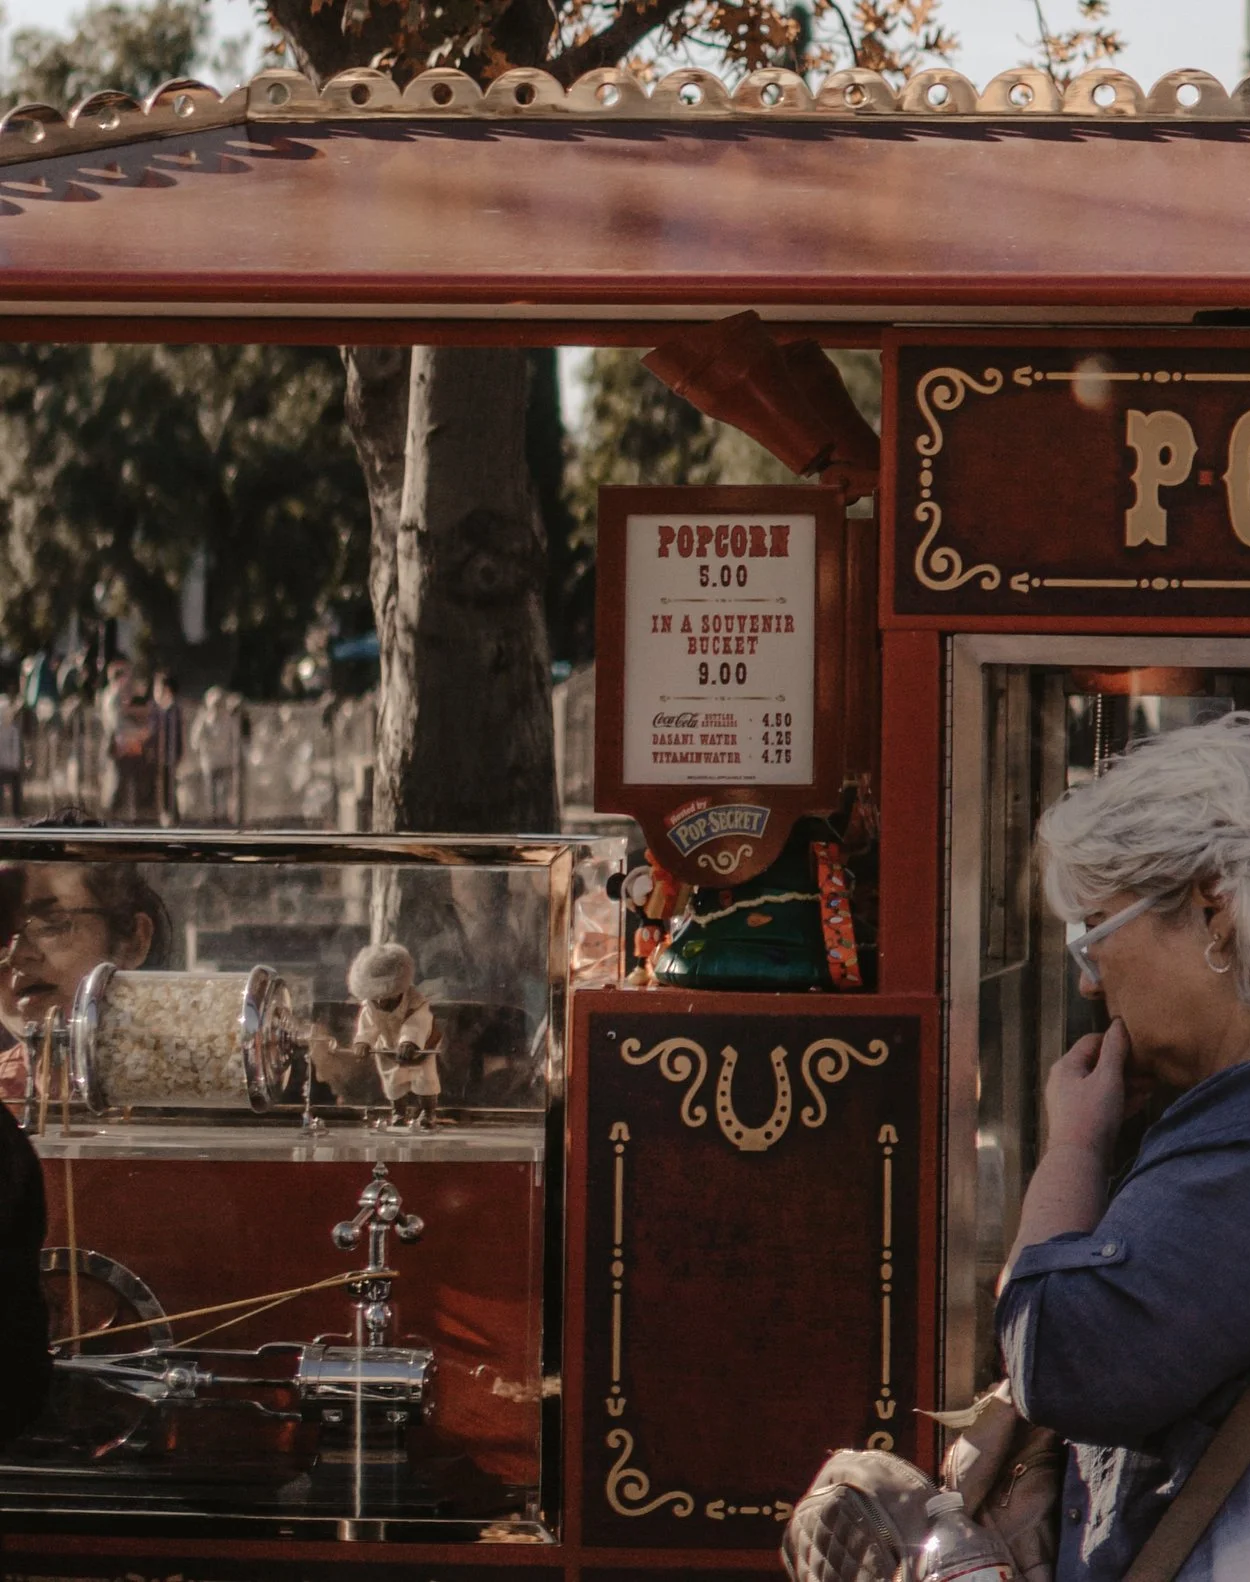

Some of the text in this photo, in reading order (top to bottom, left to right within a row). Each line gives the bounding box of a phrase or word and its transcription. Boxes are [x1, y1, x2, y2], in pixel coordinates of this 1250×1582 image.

[657, 524, 791, 559] POPCORN
[699, 564, 748, 588] 5.00
[651, 614, 795, 634] IN A SOUVENIR
[687, 635, 759, 656] BUCKET
[698, 661, 748, 686] 9.00
[762, 713, 792, 727] 4.50
[652, 731, 792, 746] DASANI WATER 4.25
[652, 749, 792, 764] VITAMINWATER 4.75
